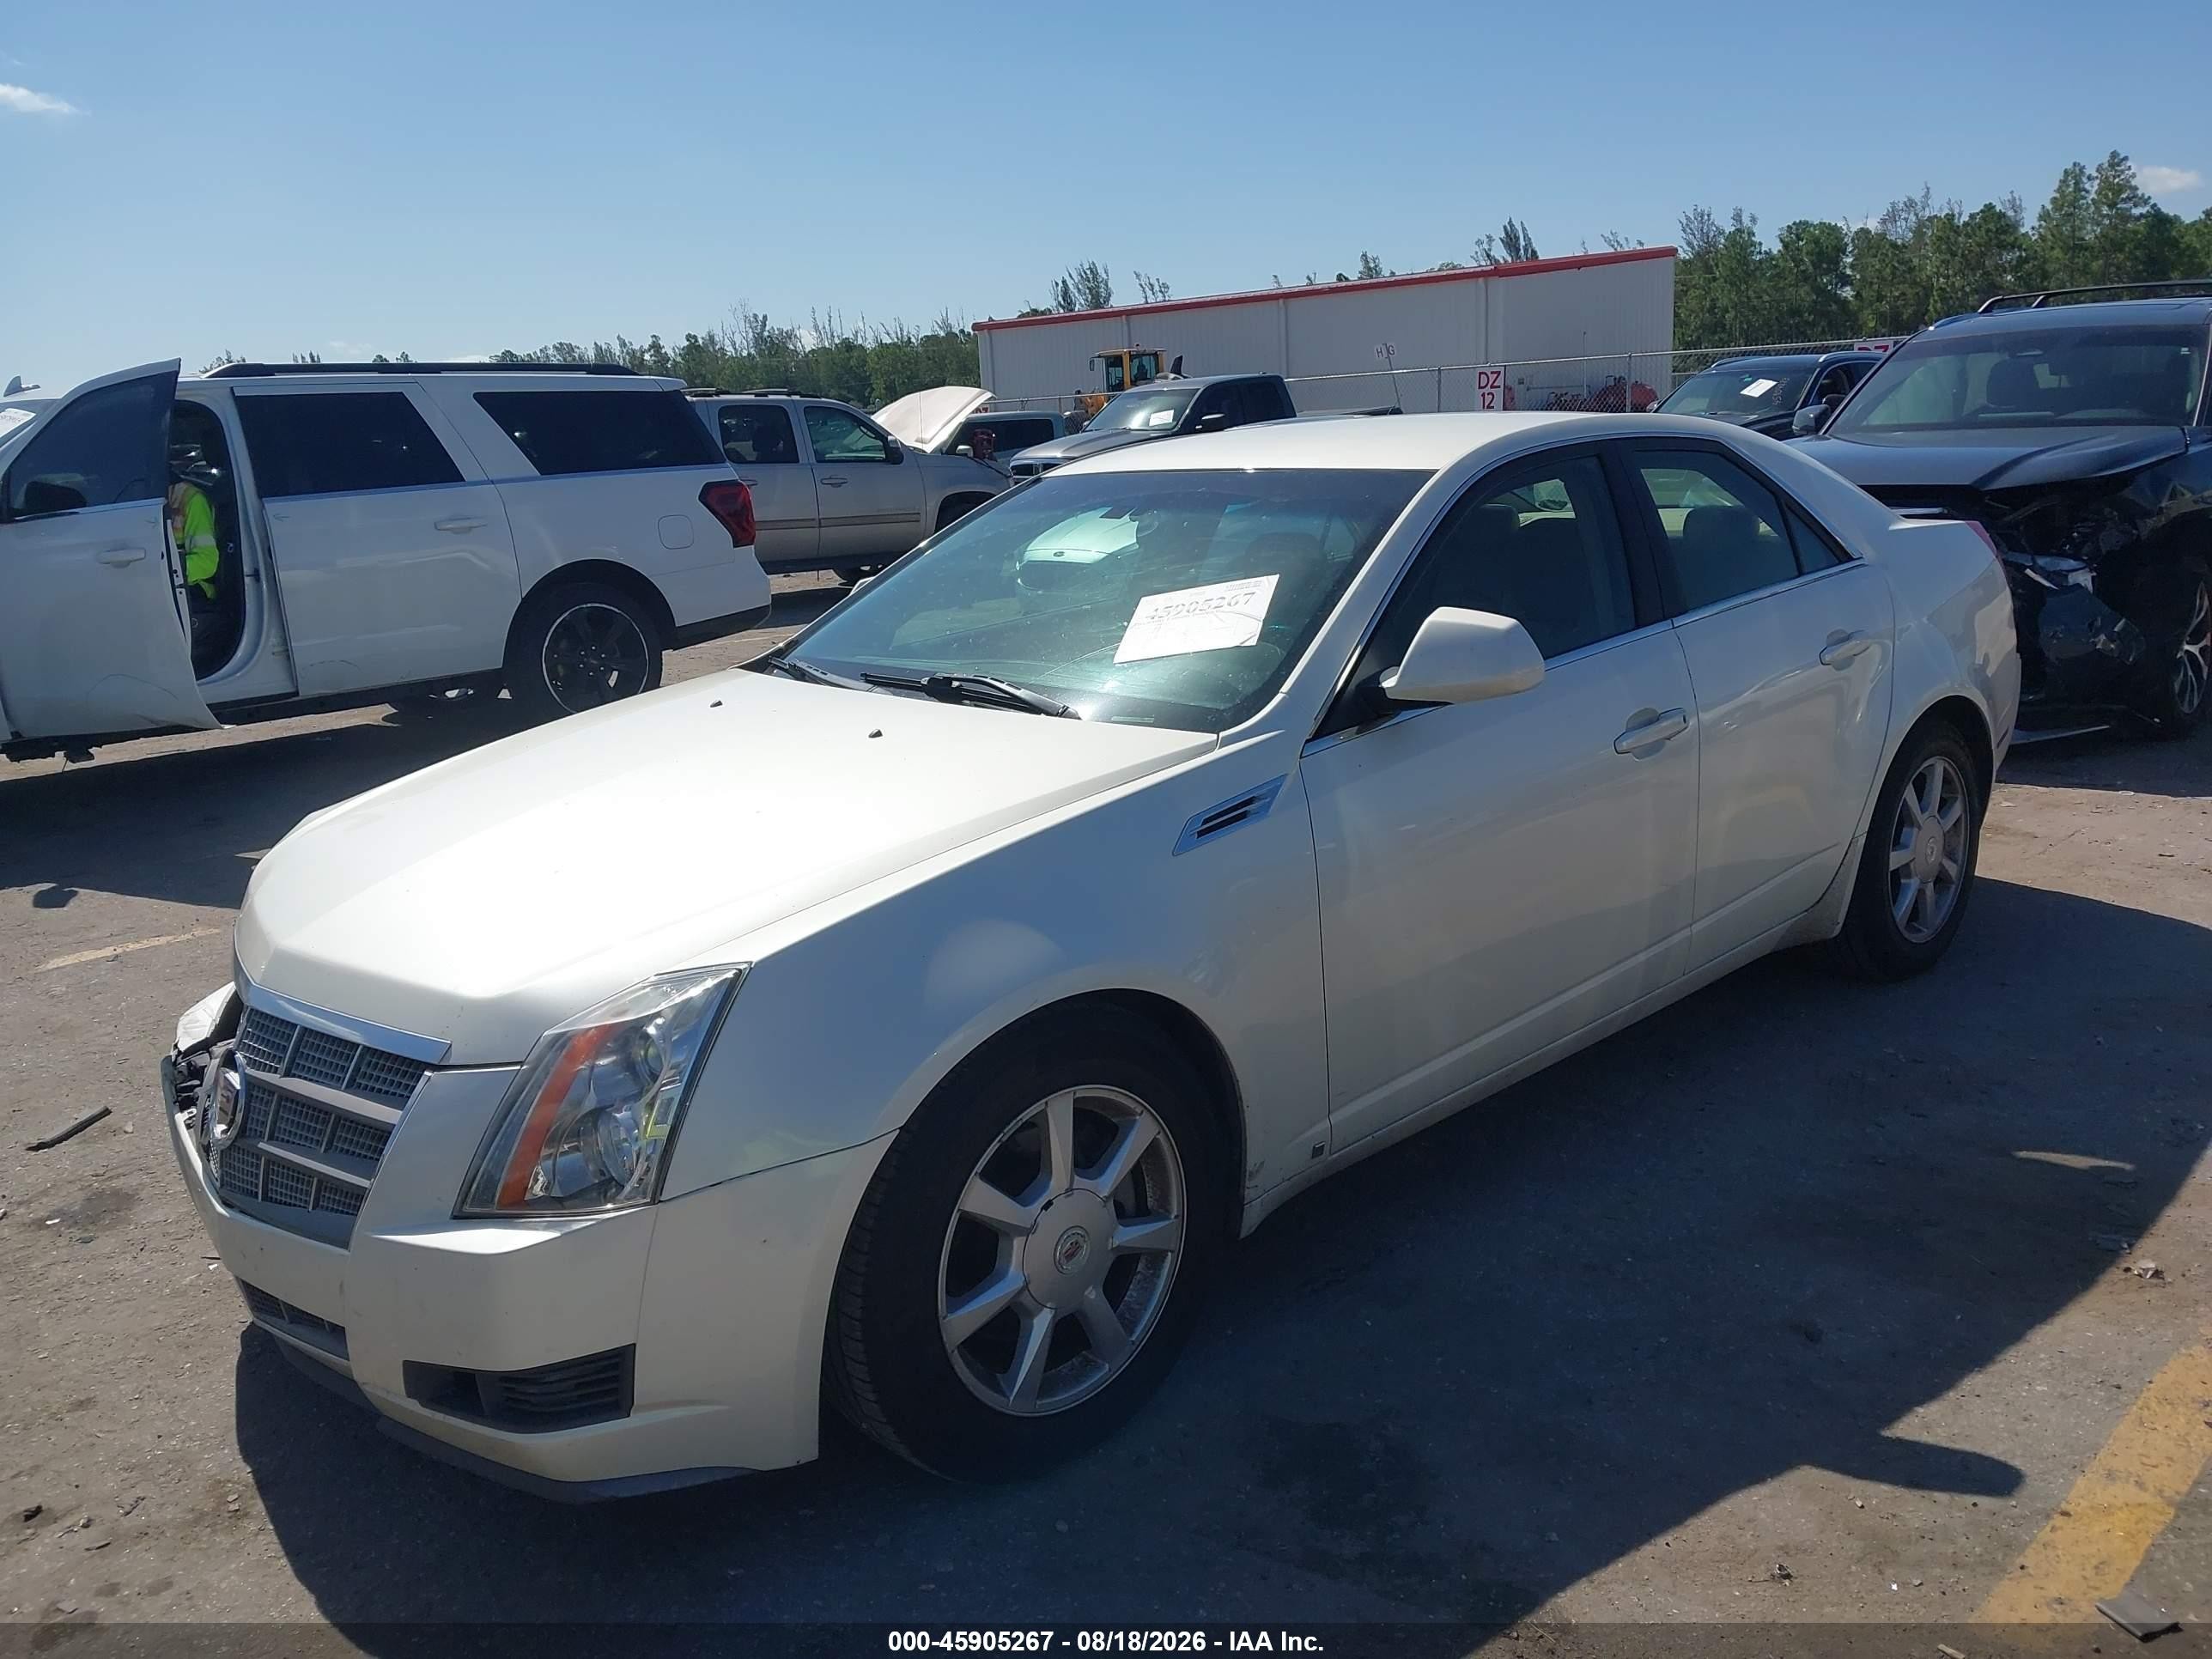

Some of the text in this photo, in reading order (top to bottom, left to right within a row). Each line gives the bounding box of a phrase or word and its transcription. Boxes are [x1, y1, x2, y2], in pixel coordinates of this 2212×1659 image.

[1478, 370, 1502, 390] DZ
[1480, 392, 1495, 410] 12
[1146, 591, 1256, 620] 45905267
